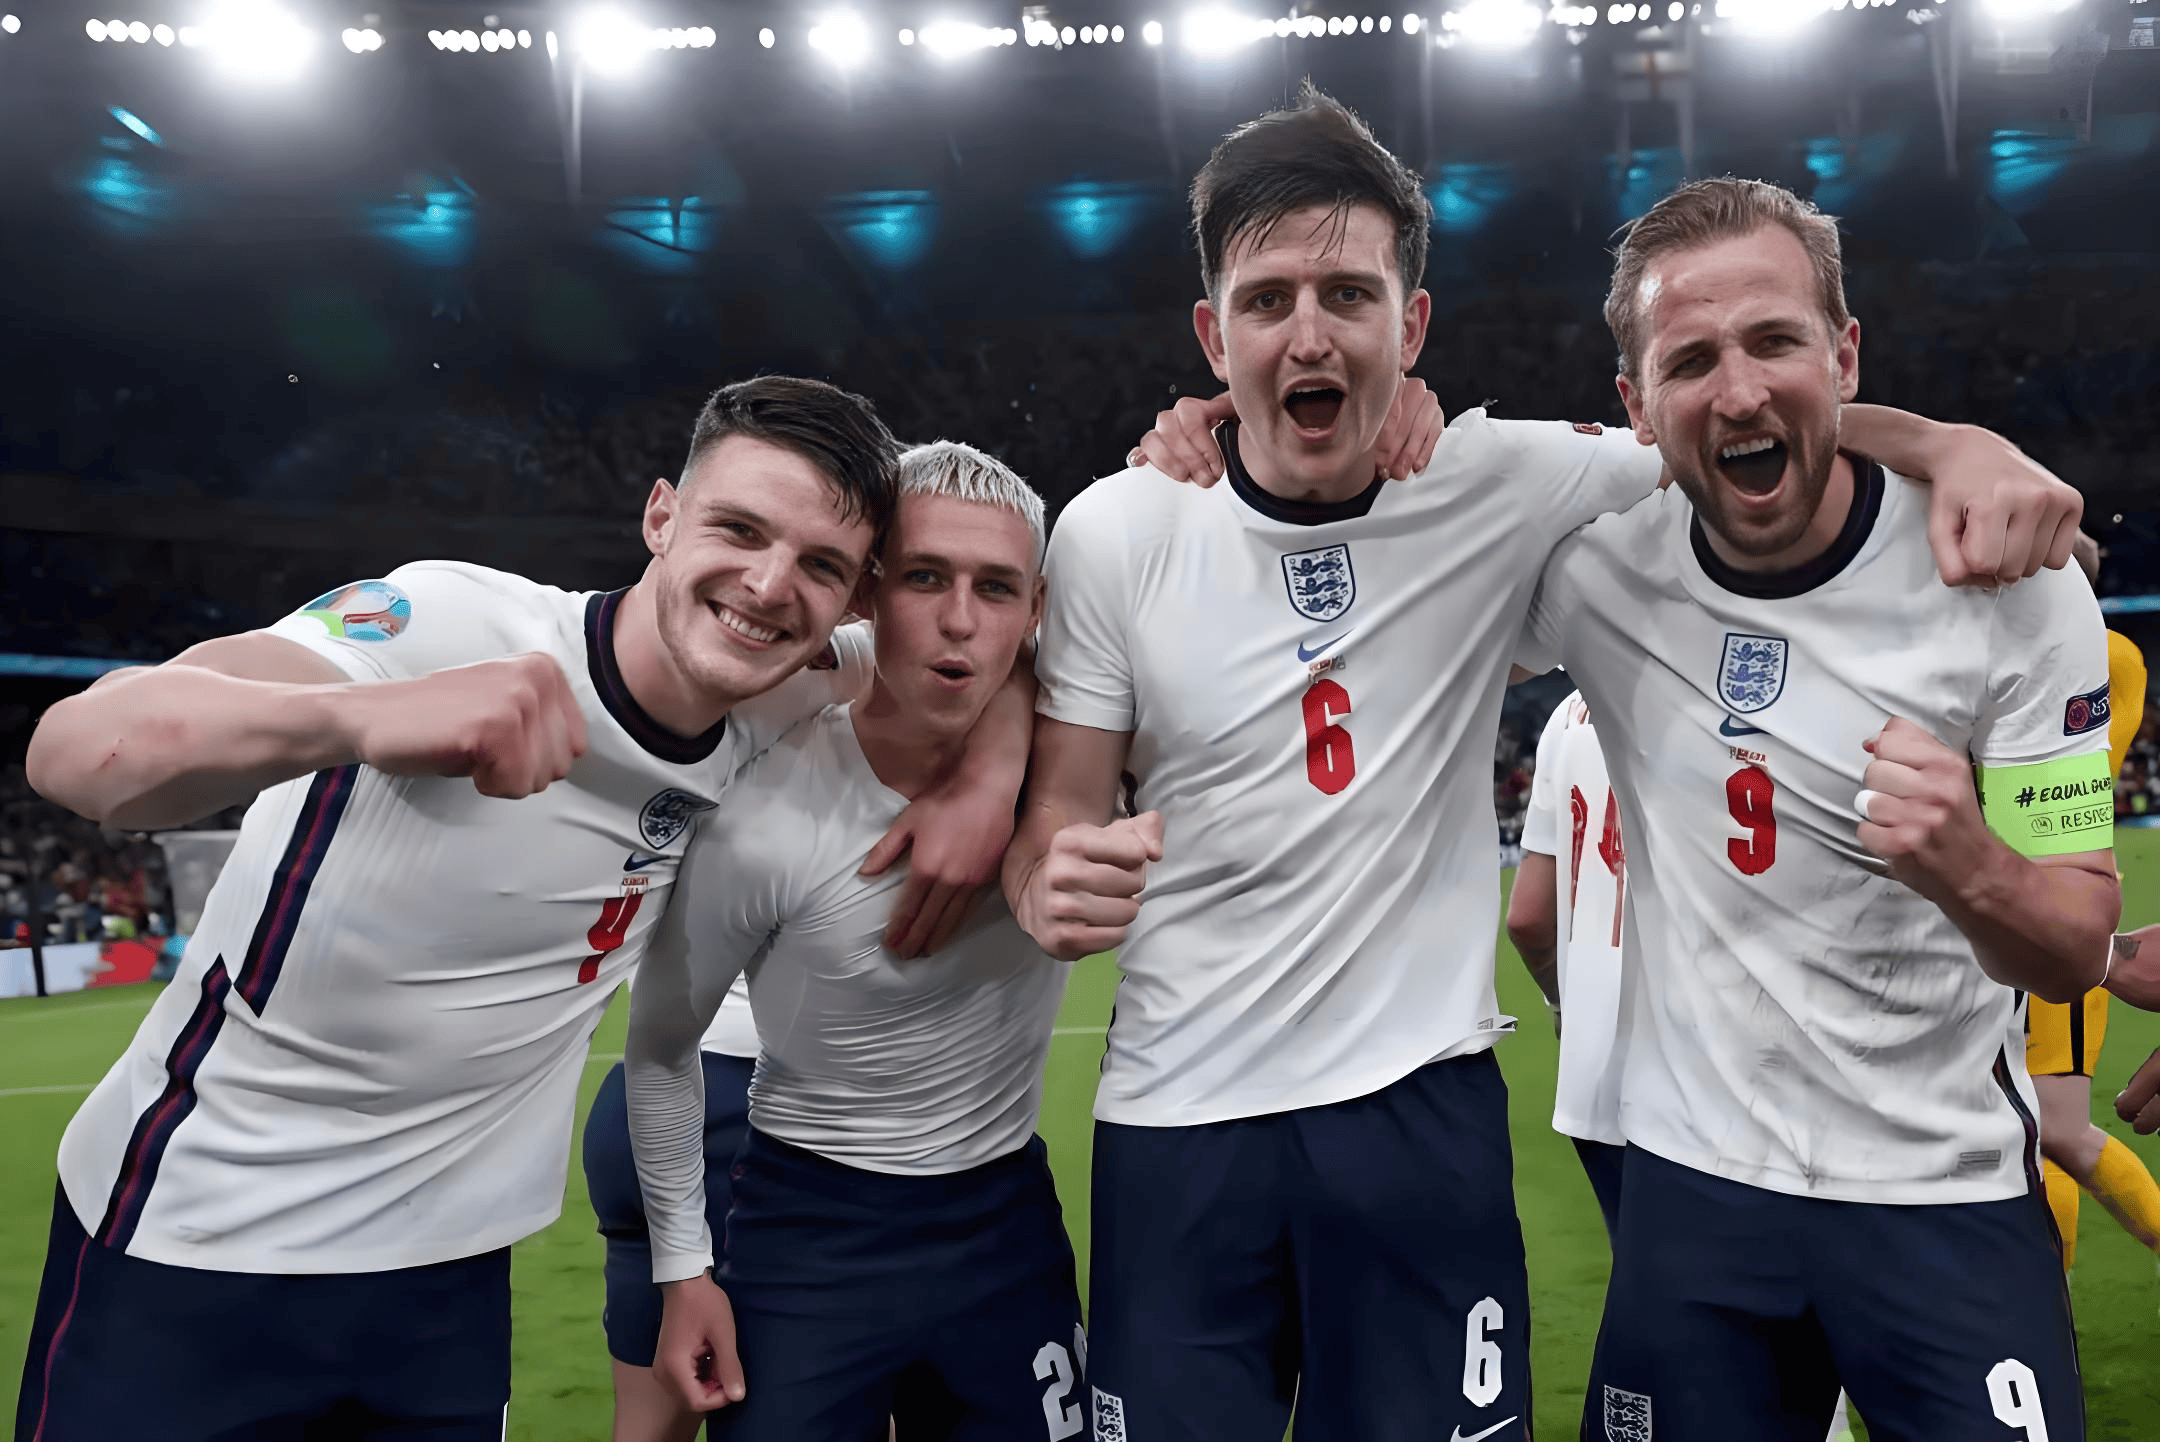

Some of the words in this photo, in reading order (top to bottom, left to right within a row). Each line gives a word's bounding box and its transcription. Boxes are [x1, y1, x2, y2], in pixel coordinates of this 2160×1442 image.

[1302, 678, 1356, 795] 6
[1726, 766, 1777, 876] 9
[1462, 1296, 1504, 1408] 6
[1985, 1358, 2049, 1442] 9
